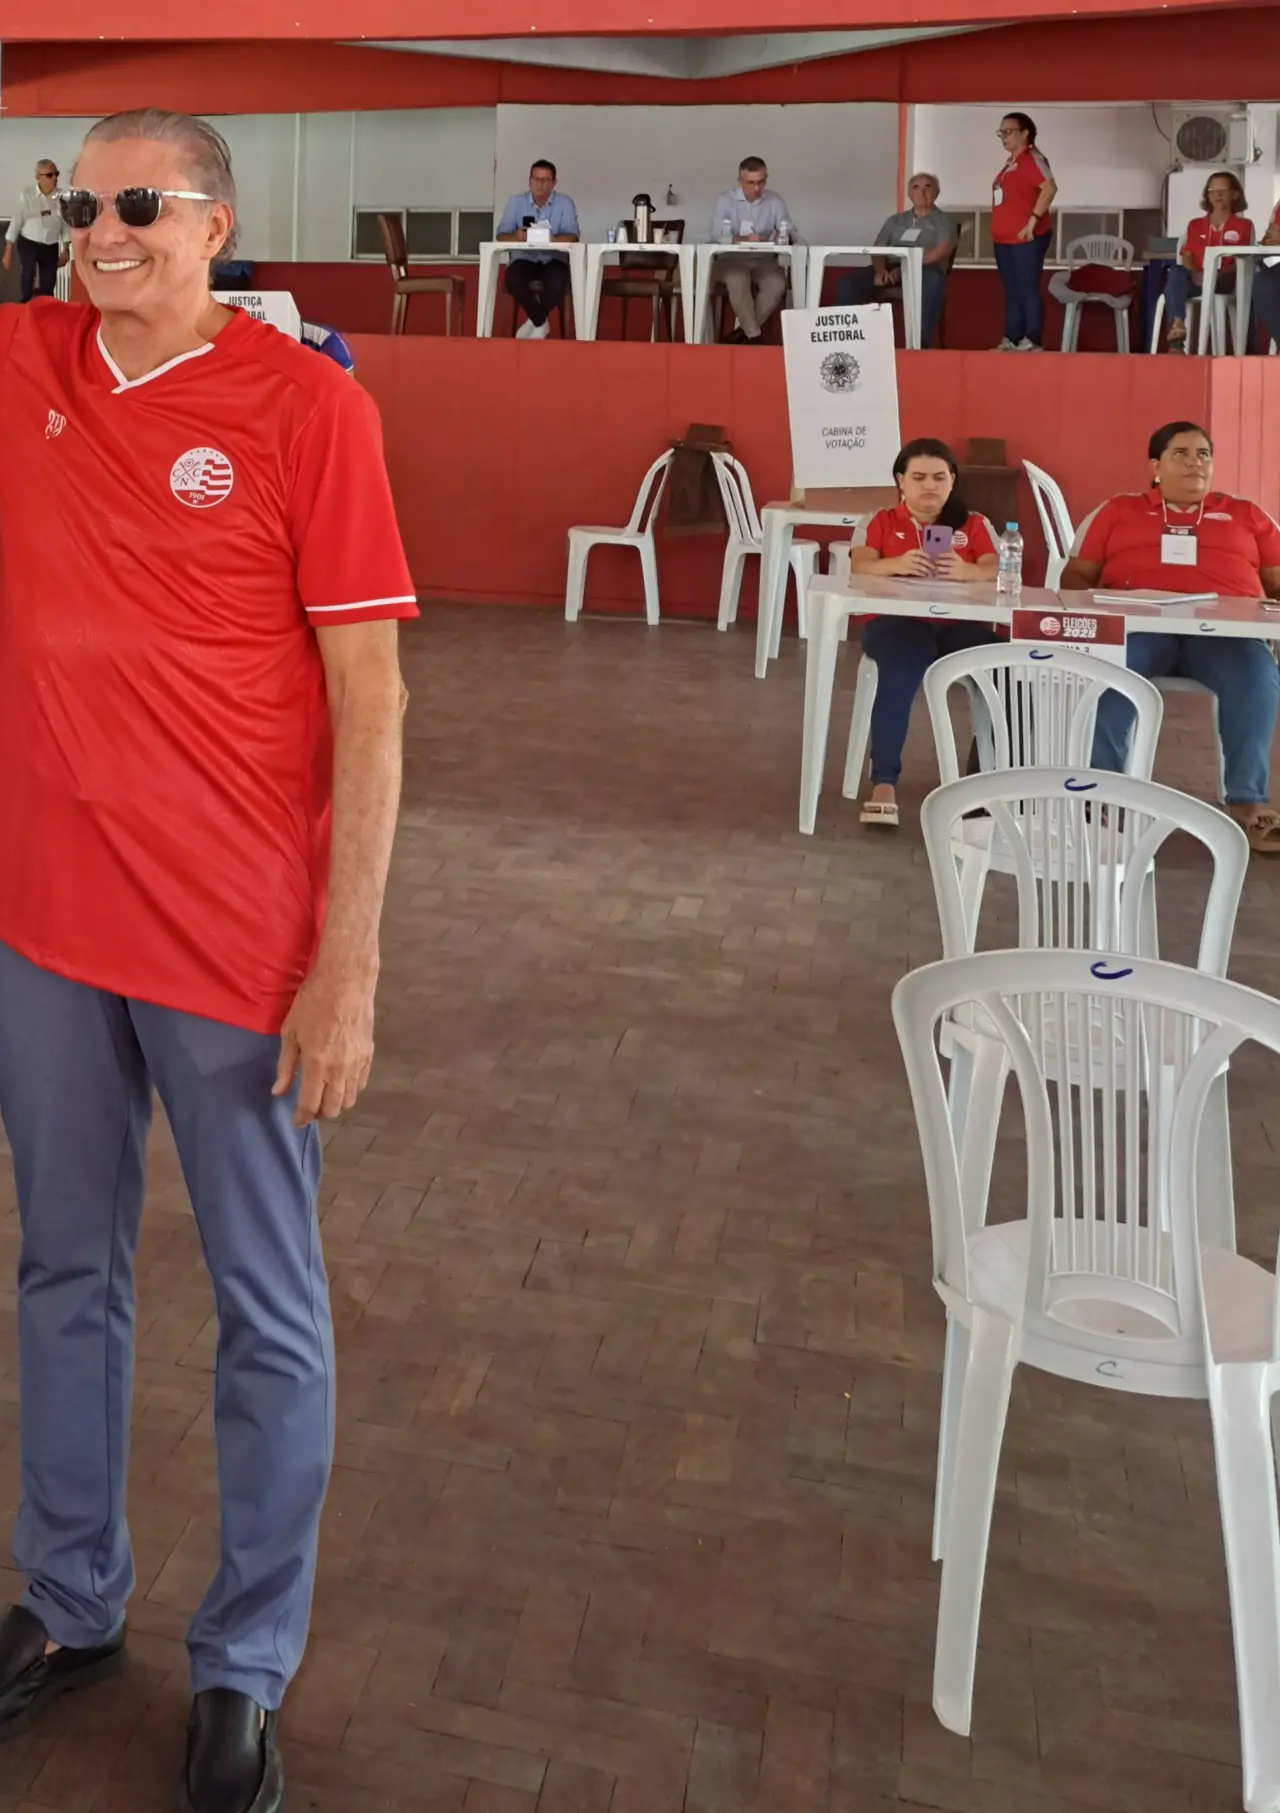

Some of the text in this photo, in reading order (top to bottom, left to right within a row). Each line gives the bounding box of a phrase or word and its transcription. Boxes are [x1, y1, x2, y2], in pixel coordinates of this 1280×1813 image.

[228, 296, 262, 308] JUSTIÇA
[815, 313, 859, 327] JUSTIÇA
[810, 329, 866, 343] ELEITORAL
[821, 426, 868, 437] CABINA DE
[825, 438, 866, 450] VOTAÇÃO
[189, 491, 205, 501] 1901
[1062, 616, 1097, 629] ELEIÇÕES
[1063, 628, 1097, 639] 2025
